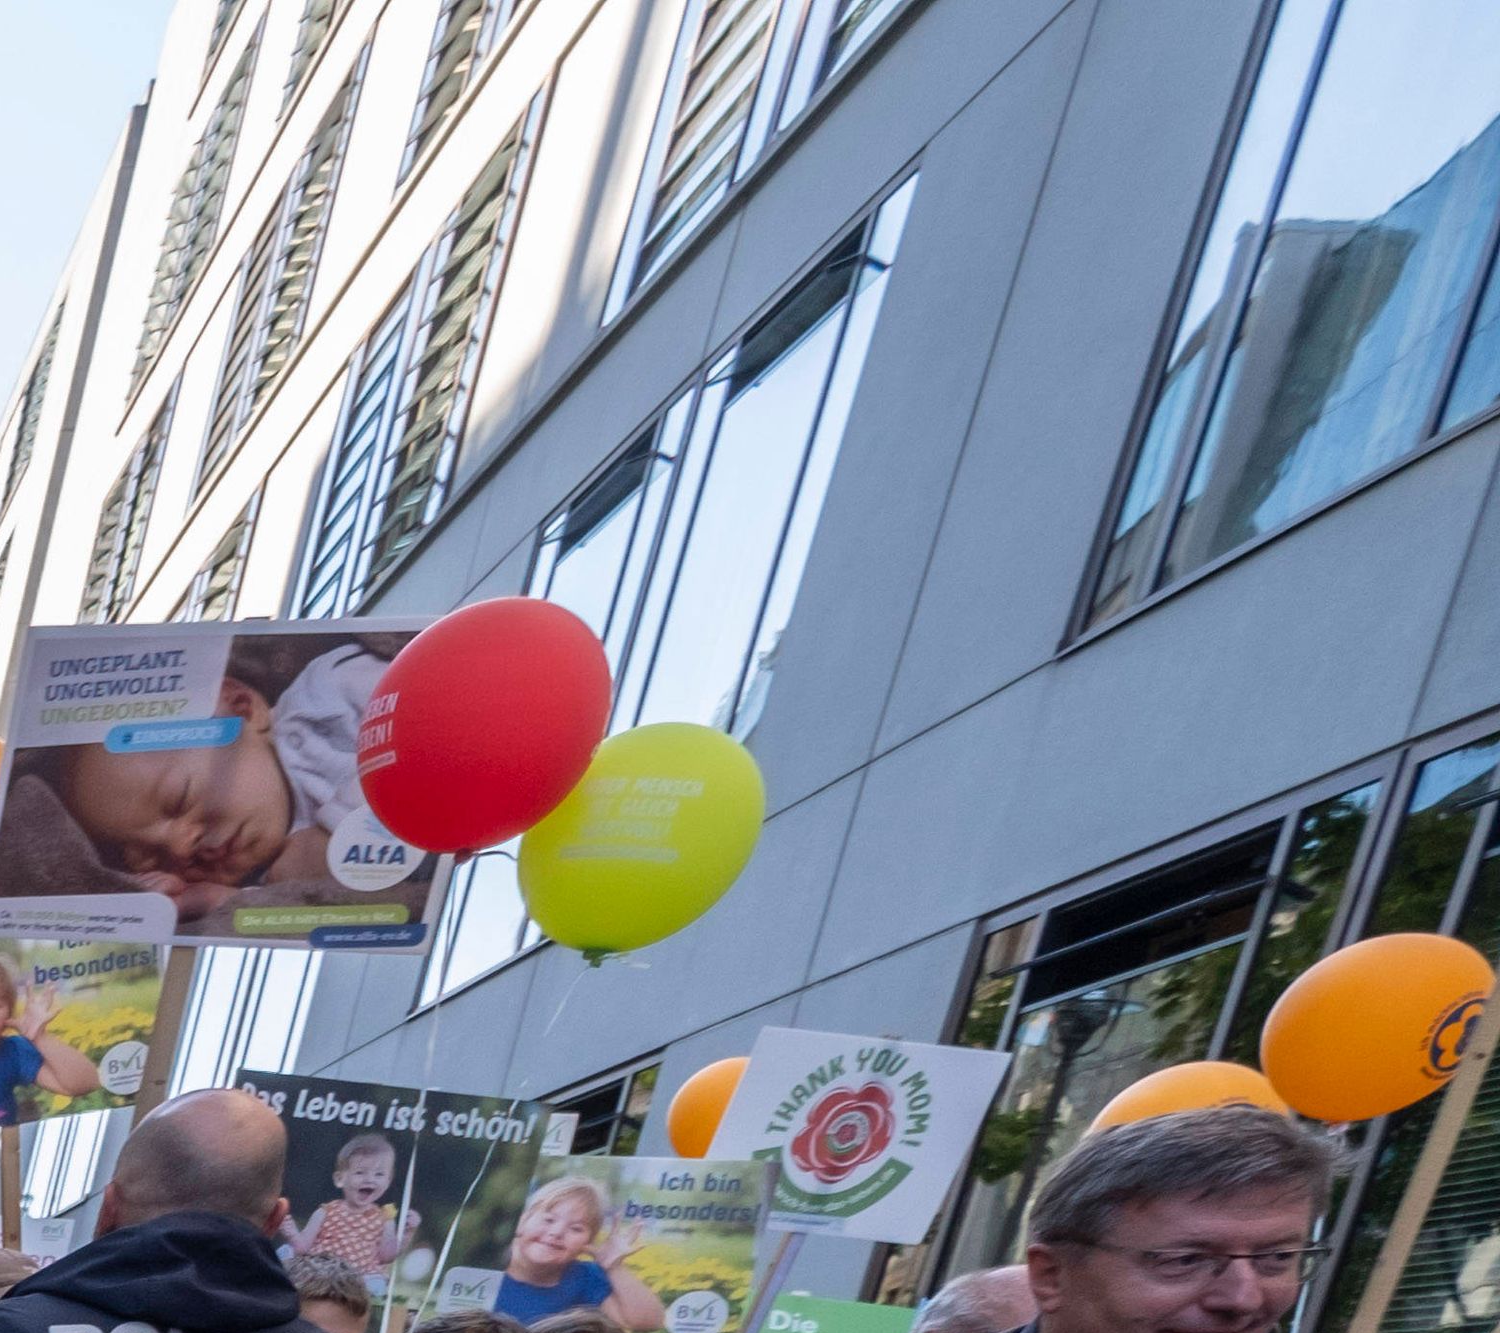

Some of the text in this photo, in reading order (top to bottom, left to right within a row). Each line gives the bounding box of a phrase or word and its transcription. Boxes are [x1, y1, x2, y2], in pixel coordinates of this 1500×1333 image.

[50, 650, 187, 678] UNGEPLANT.
[44, 675, 186, 702] UNGEWOLLT.
[40, 699, 188, 725] UNGEBOREN?
[34, 943, 158, 985] besonders!
[764, 1047, 932, 1148] THANK YOU MOM!
[292, 1089, 376, 1127] Leben
[383, 1098, 428, 1132] ist
[434, 1110, 538, 1144] schön!
[659, 1172, 742, 1192] Ich bin
[624, 1199, 761, 1222] besonders!
